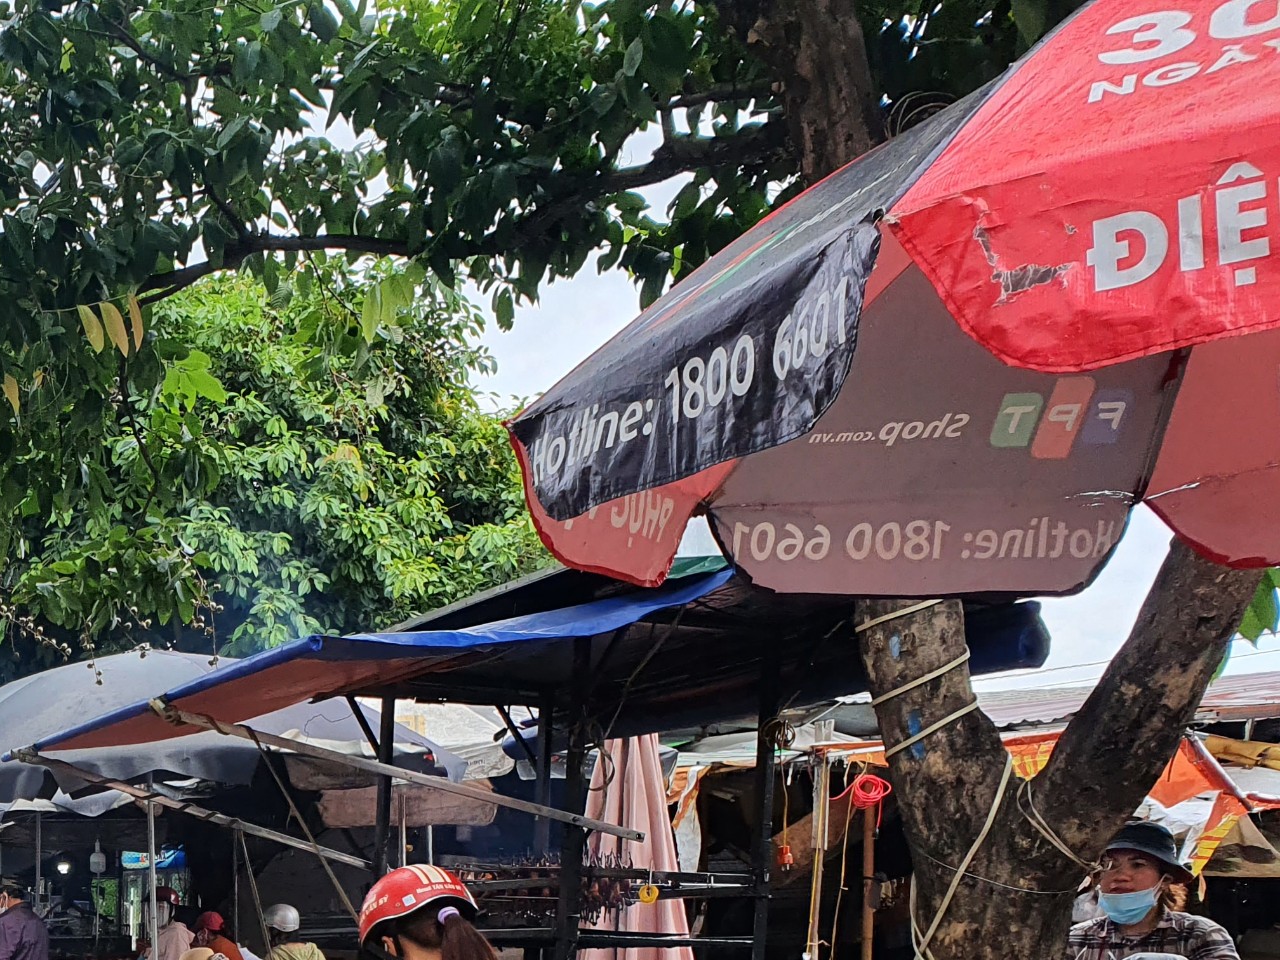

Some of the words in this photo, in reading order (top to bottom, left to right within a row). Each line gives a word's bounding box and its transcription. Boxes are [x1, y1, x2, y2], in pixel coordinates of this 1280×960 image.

[1087, 161, 1280, 292] ĐIỆ
[532, 399, 653, 486] Hotline:
[665, 334, 755, 424] 1800
[773, 276, 848, 381] 6601
